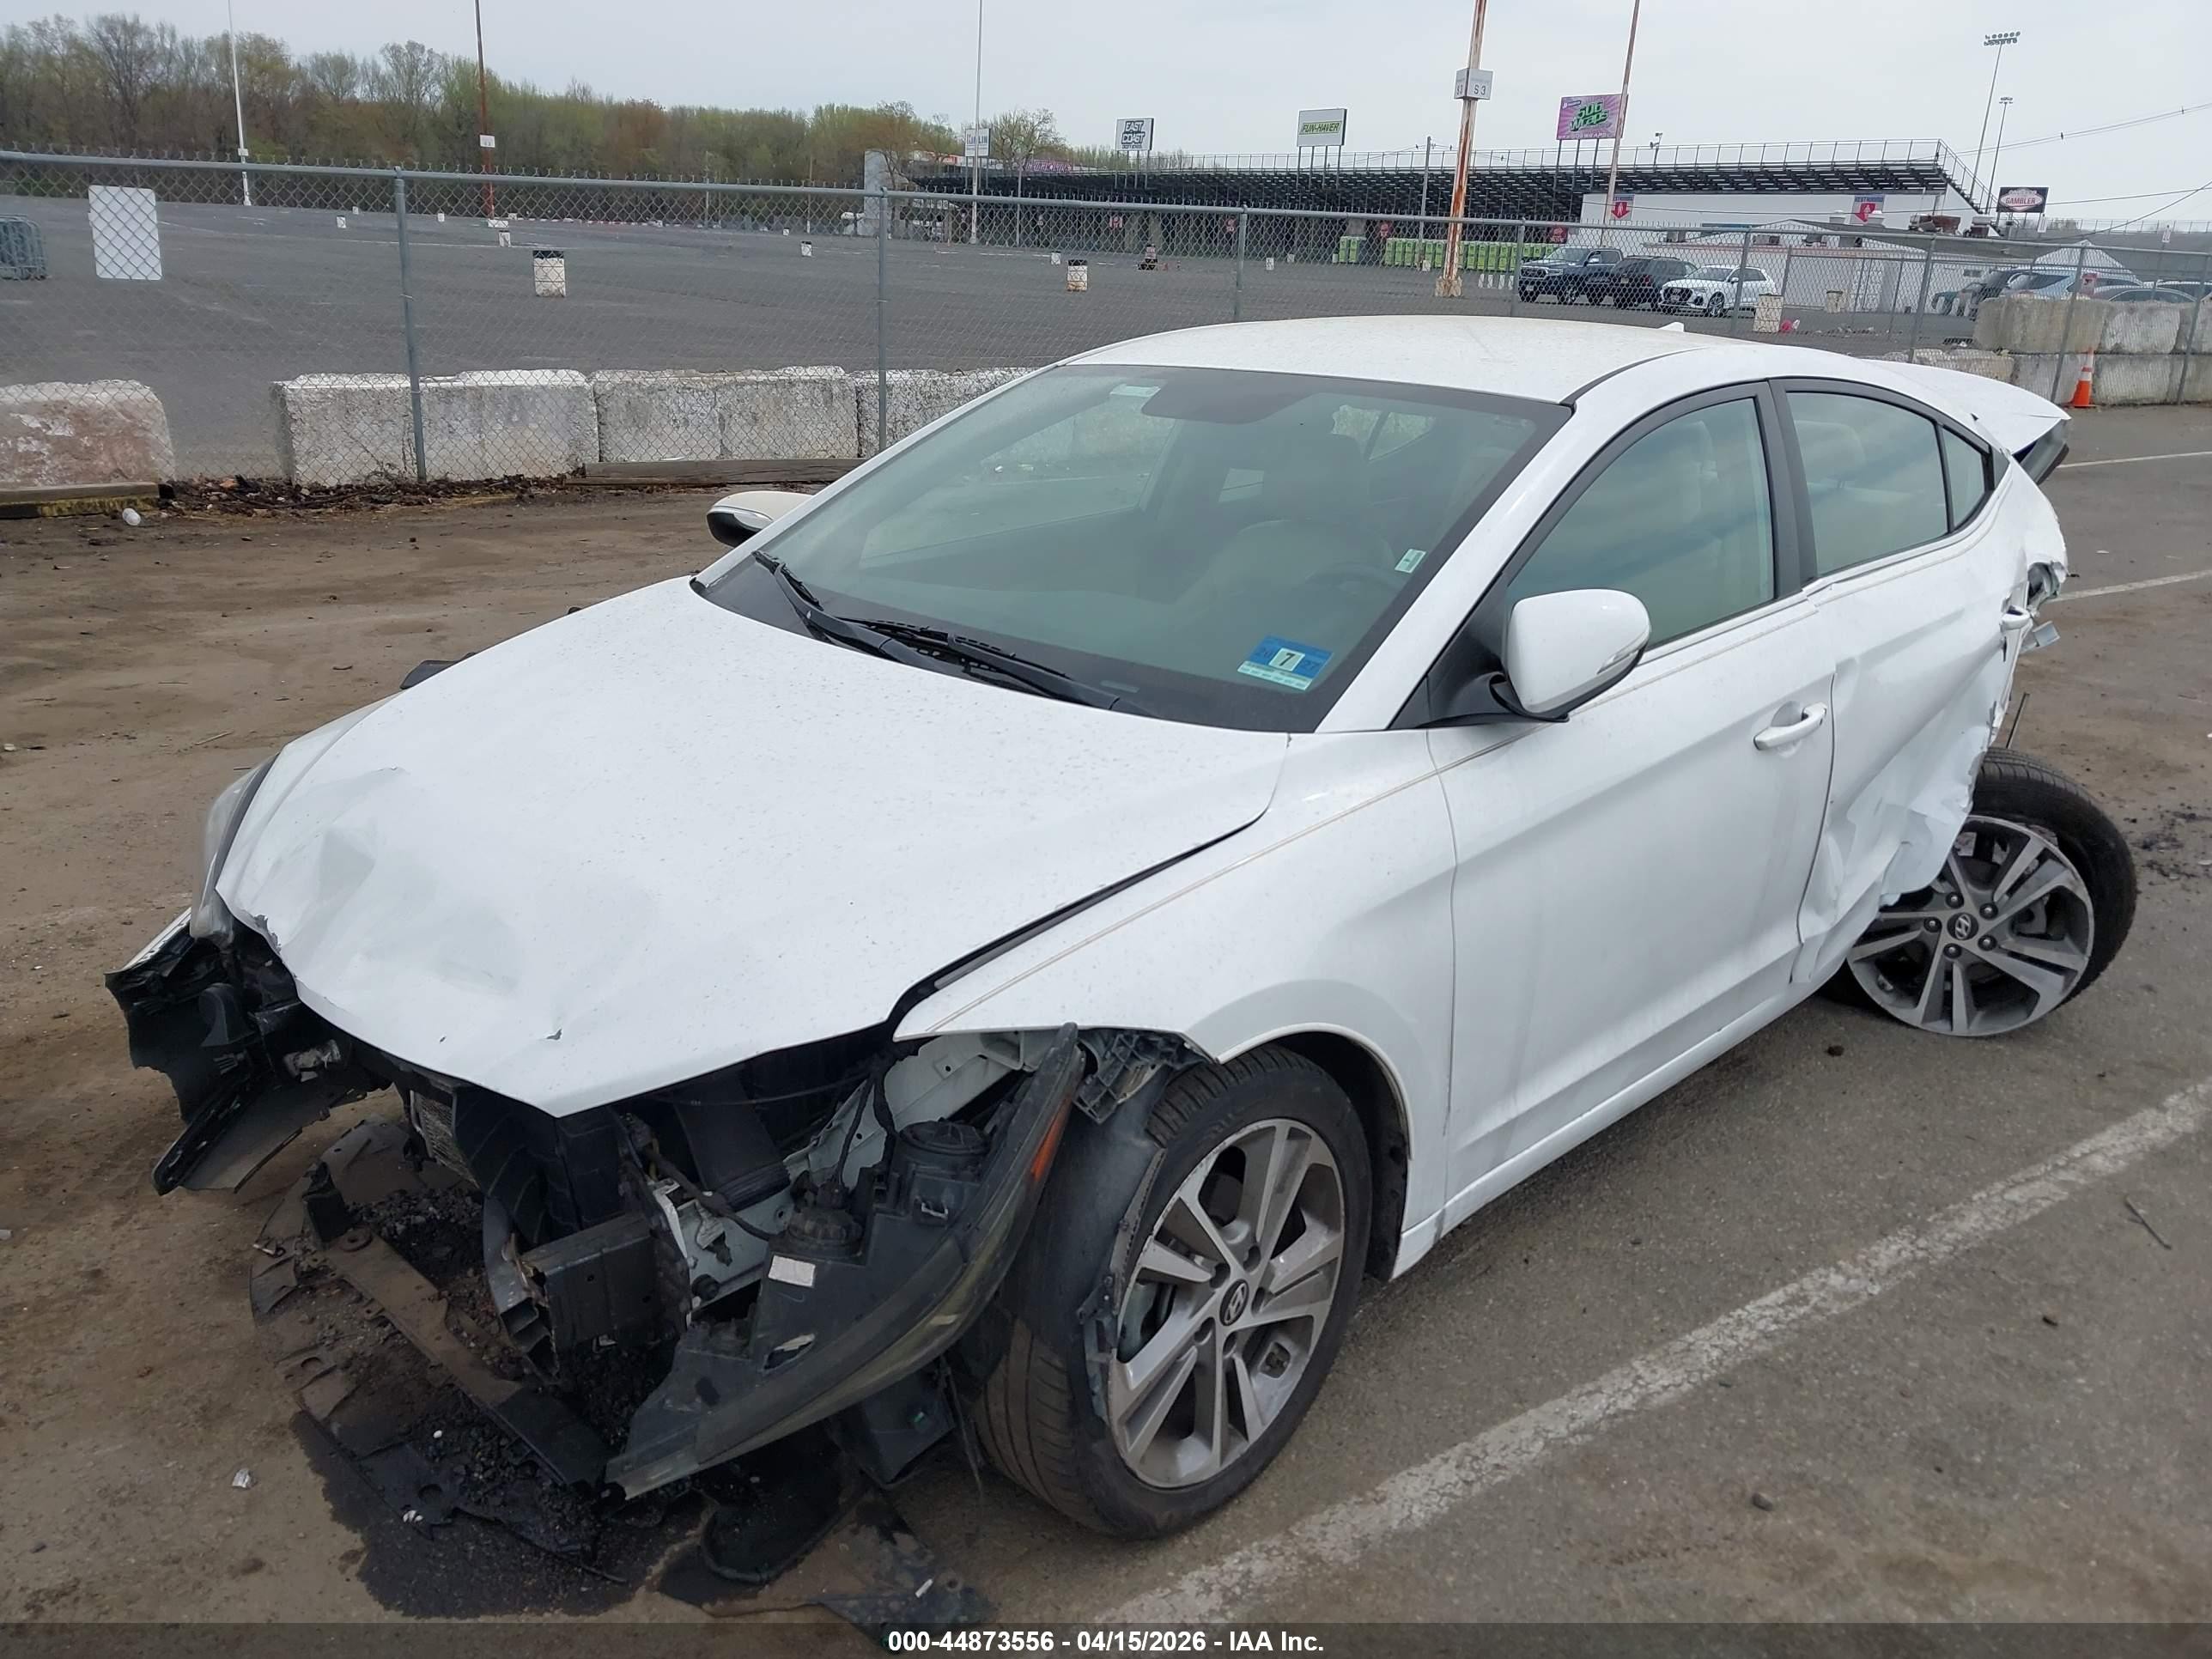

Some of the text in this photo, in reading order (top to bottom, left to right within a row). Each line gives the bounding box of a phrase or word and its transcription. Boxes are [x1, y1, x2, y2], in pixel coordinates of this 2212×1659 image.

[1125, 120, 1144, 131] EAST
[1121, 131, 1146, 144] COAST
[2005, 197, 2036, 205] GAMBLER
[1278, 653, 1296, 667] 7
